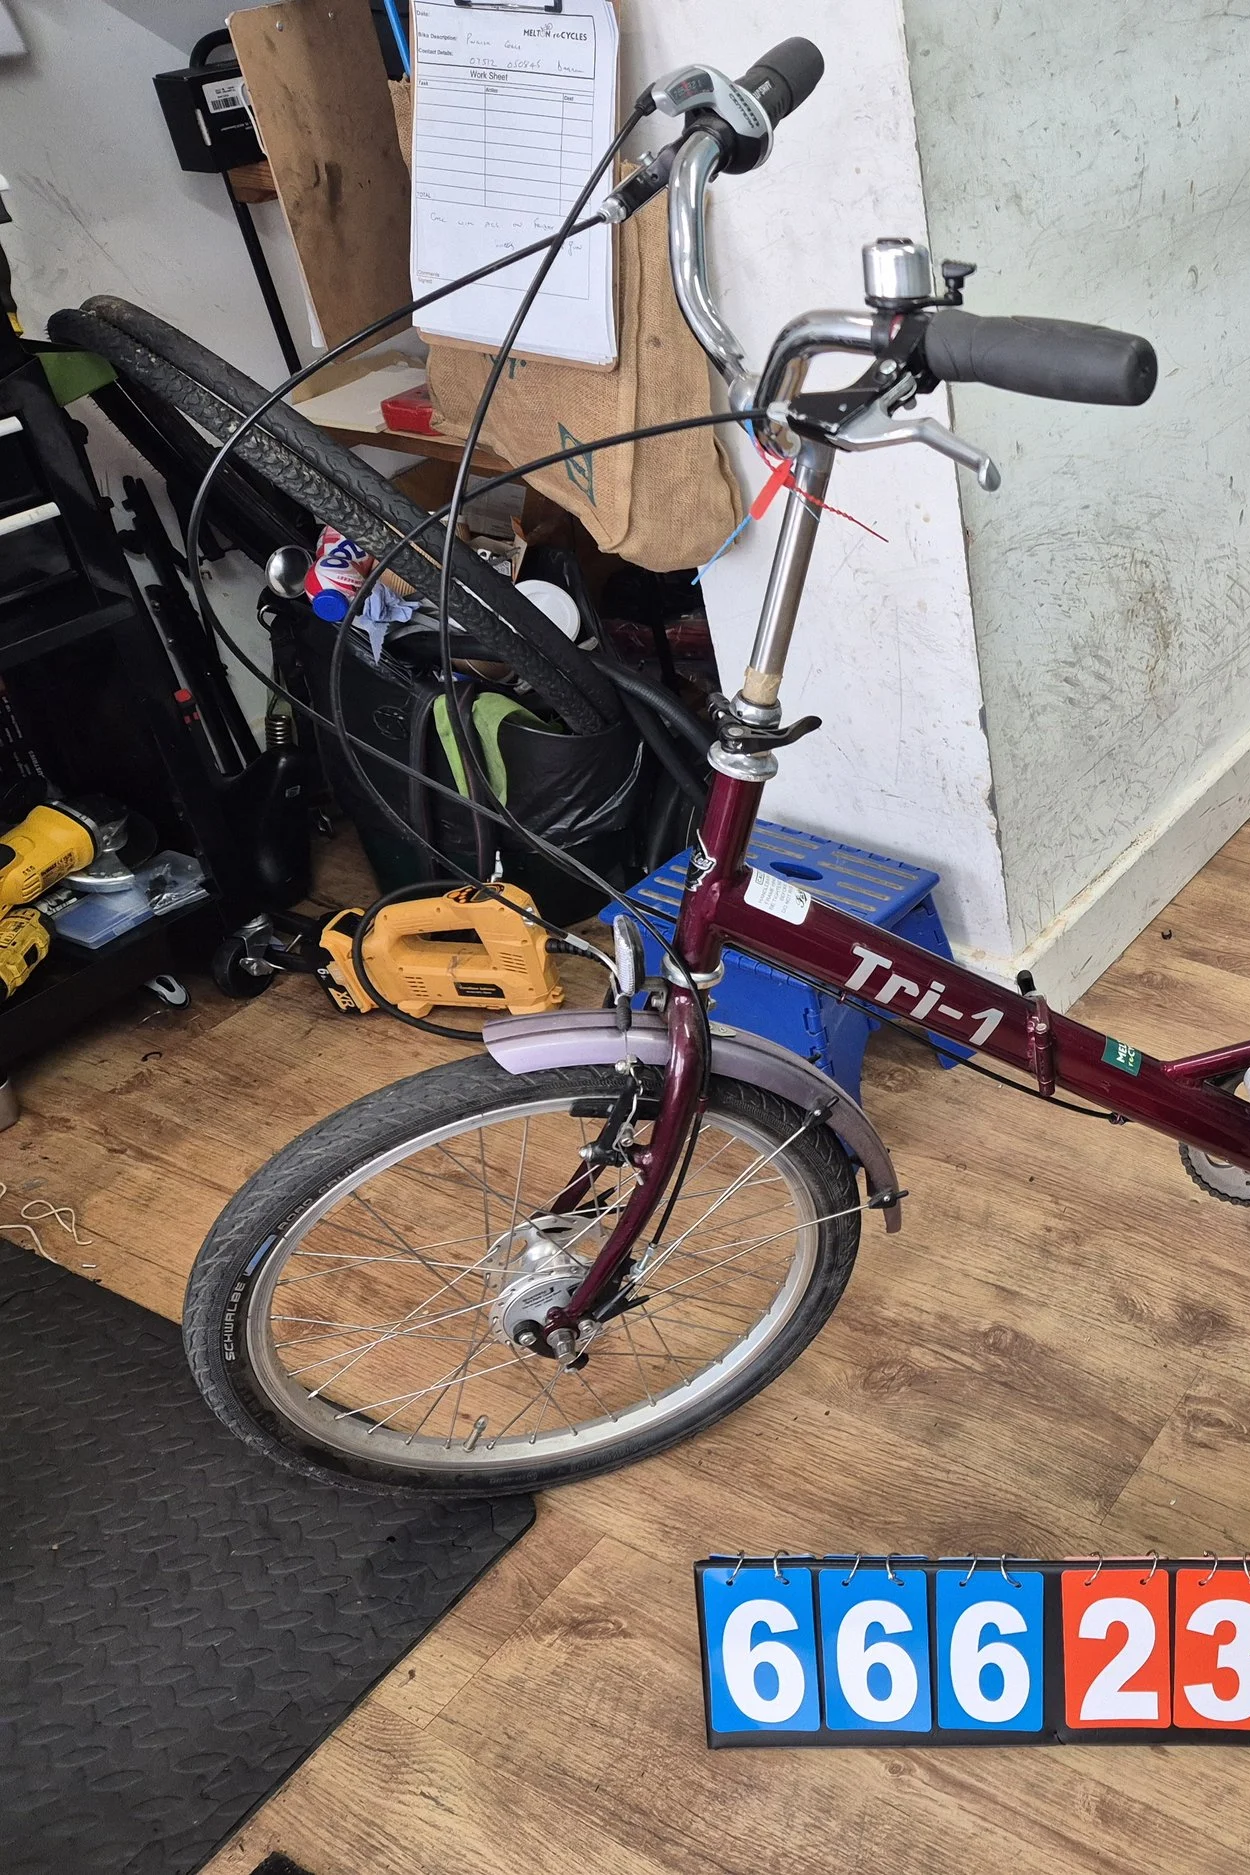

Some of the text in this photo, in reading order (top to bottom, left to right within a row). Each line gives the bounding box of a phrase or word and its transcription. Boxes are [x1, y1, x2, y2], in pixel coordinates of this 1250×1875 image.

[469, 69, 508, 81] Work Sheet
[844, 945, 1005, 1046] Tri-1
[224, 1281, 246, 1362] SCHWALBE
